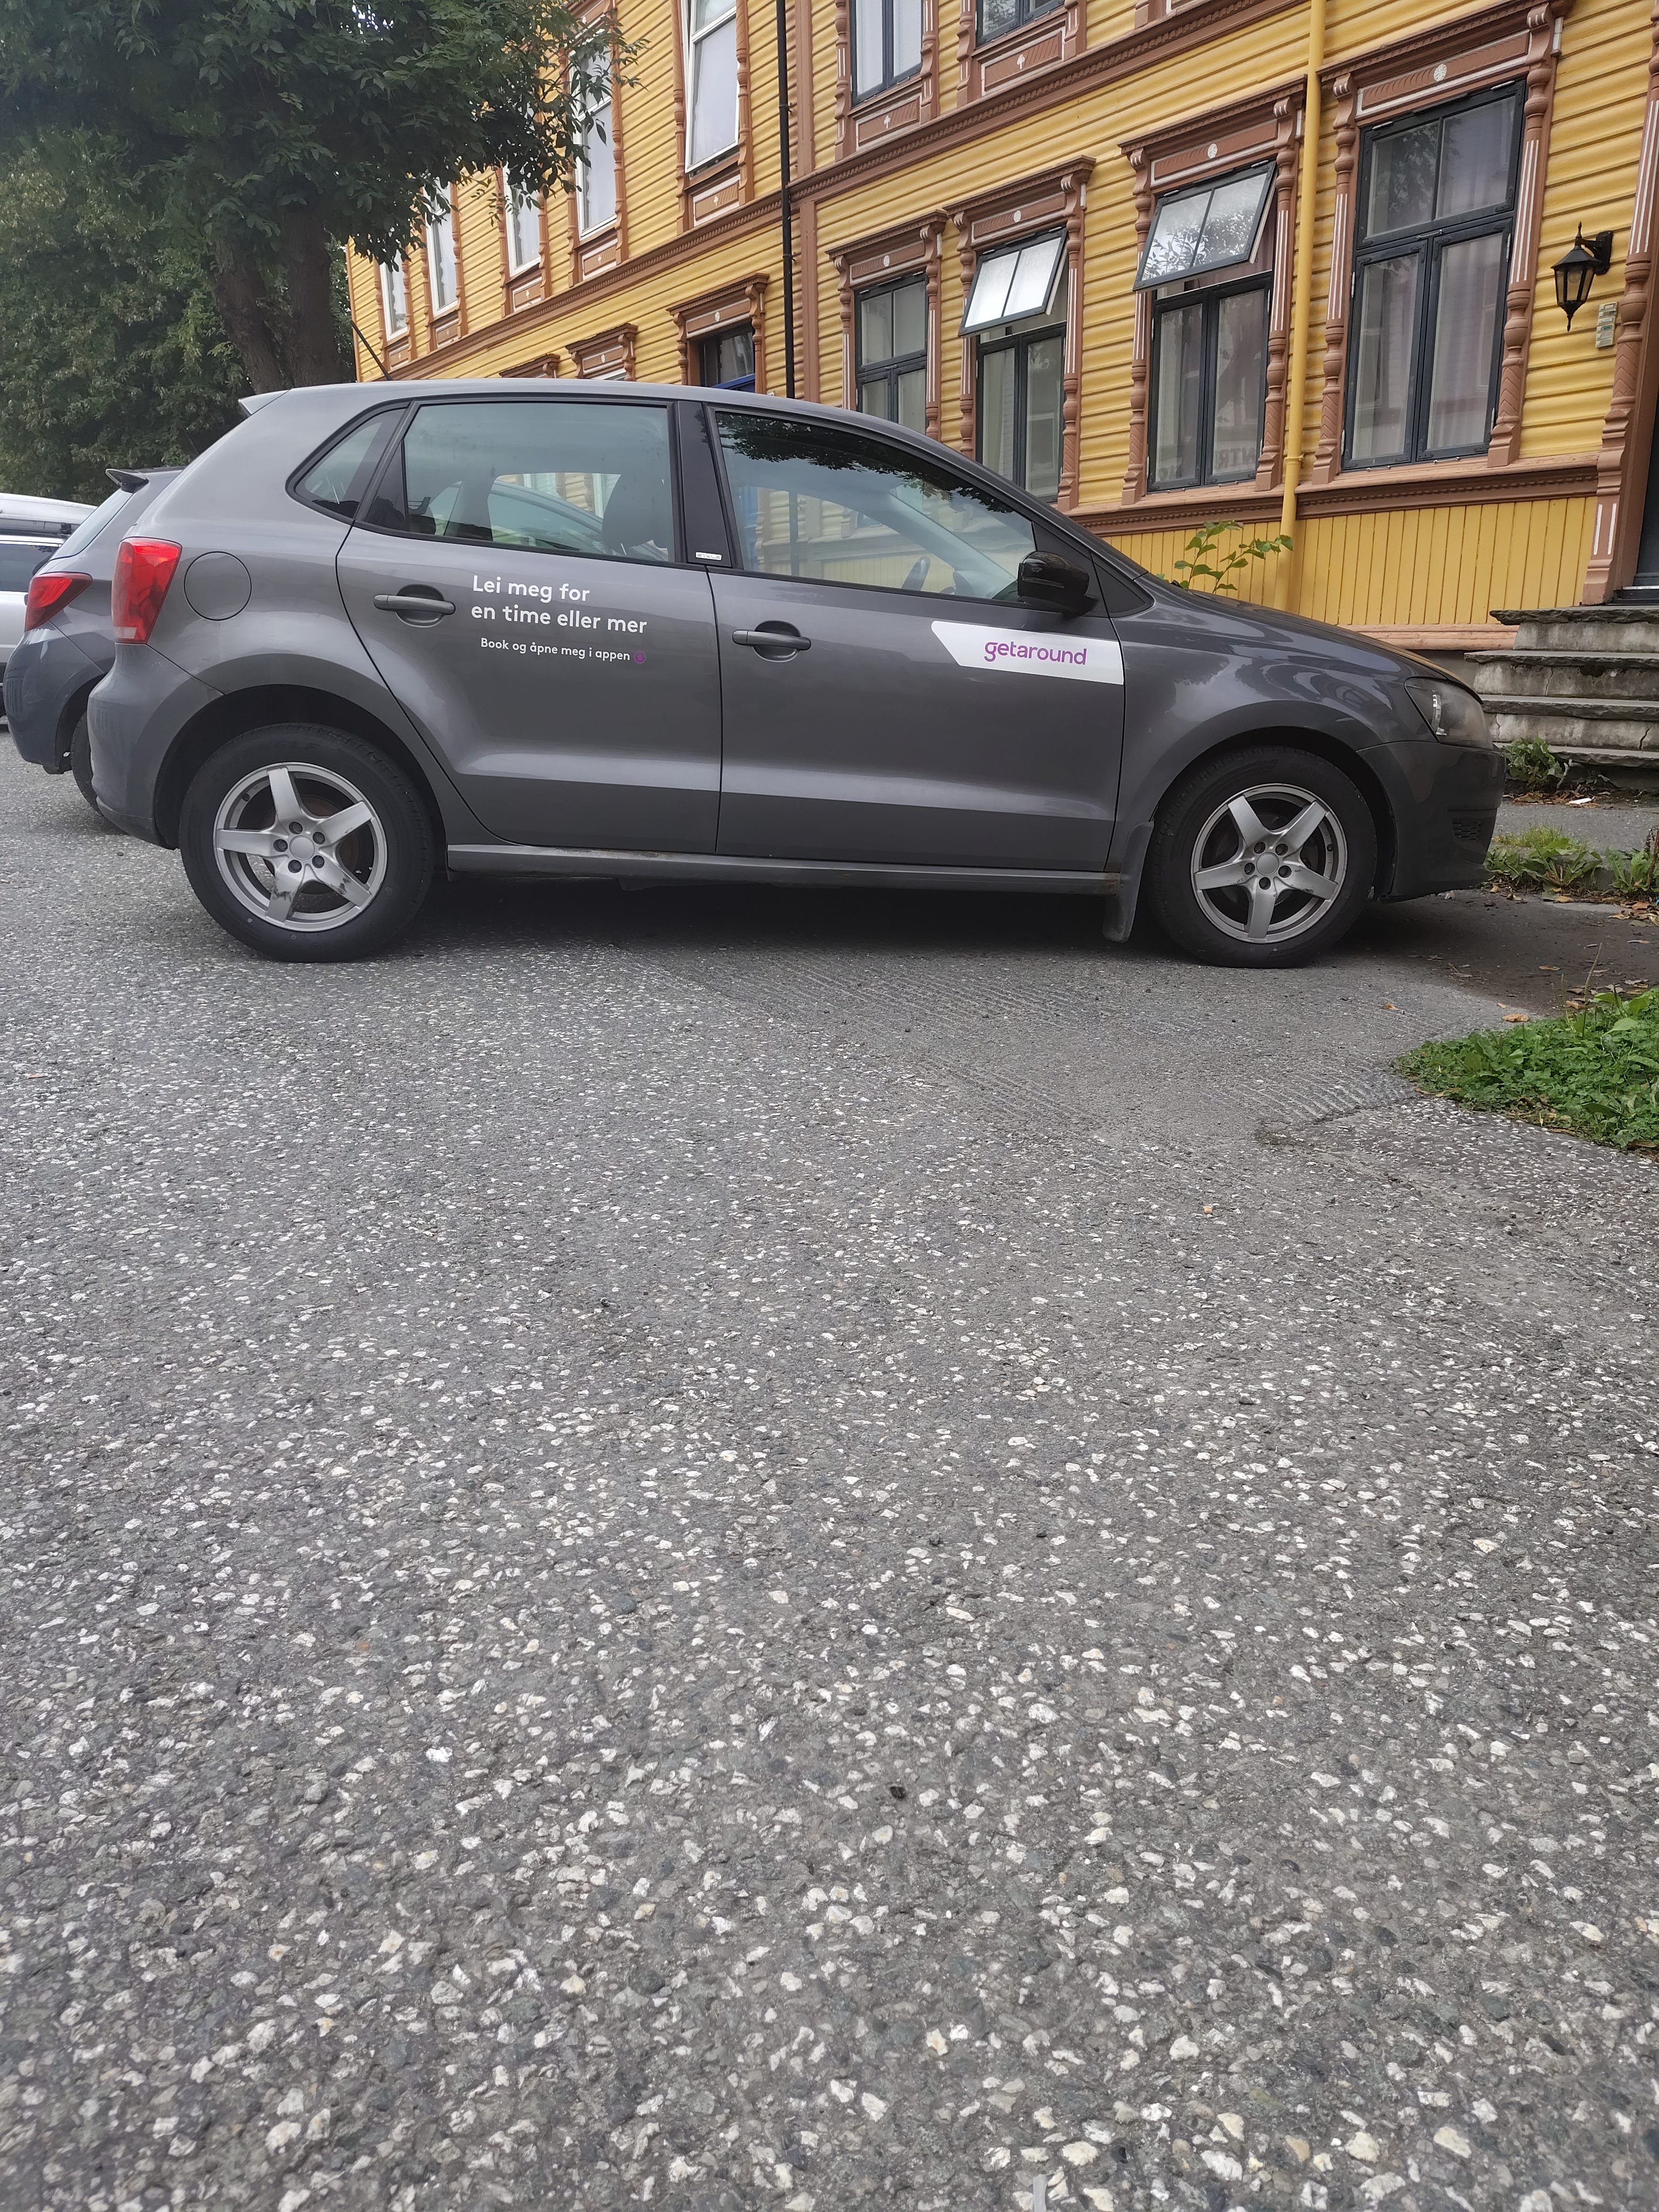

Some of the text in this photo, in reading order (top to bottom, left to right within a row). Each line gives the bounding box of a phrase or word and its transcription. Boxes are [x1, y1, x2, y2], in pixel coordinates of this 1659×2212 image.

[473, 575, 590, 603] Lei meg for
[471, 604, 648, 633] en time eller mer
[481, 637, 630, 662] Book og åpne meg i appen
[984, 641, 1087, 665] getaround
